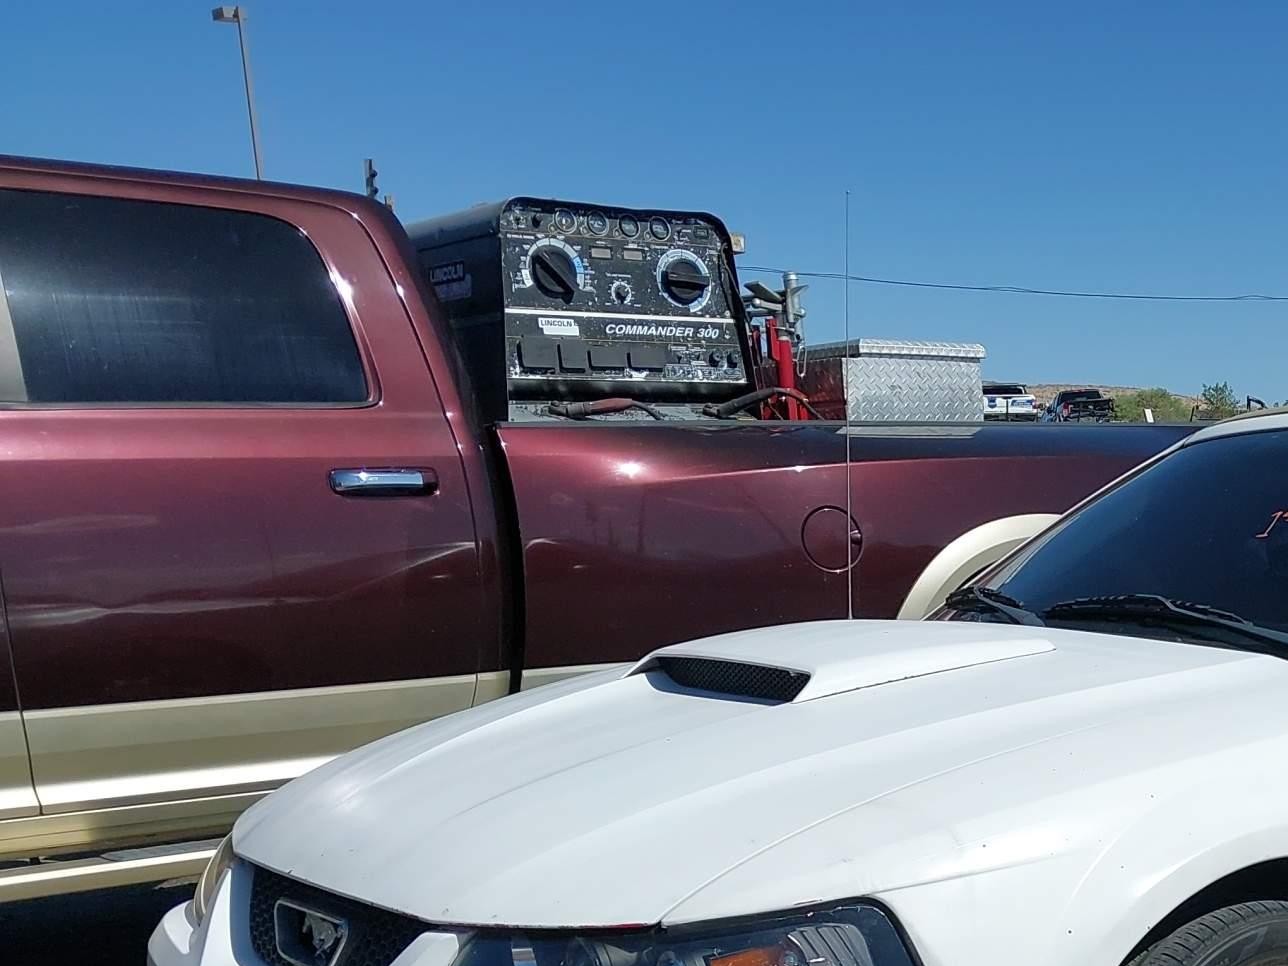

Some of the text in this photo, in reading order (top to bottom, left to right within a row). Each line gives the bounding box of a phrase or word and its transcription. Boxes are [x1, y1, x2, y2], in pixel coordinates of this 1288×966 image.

[430, 263, 464, 283] LINCOLN
[541, 319, 573, 327] LINCOLN
[605, 323, 720, 339] COMMANDER 300
